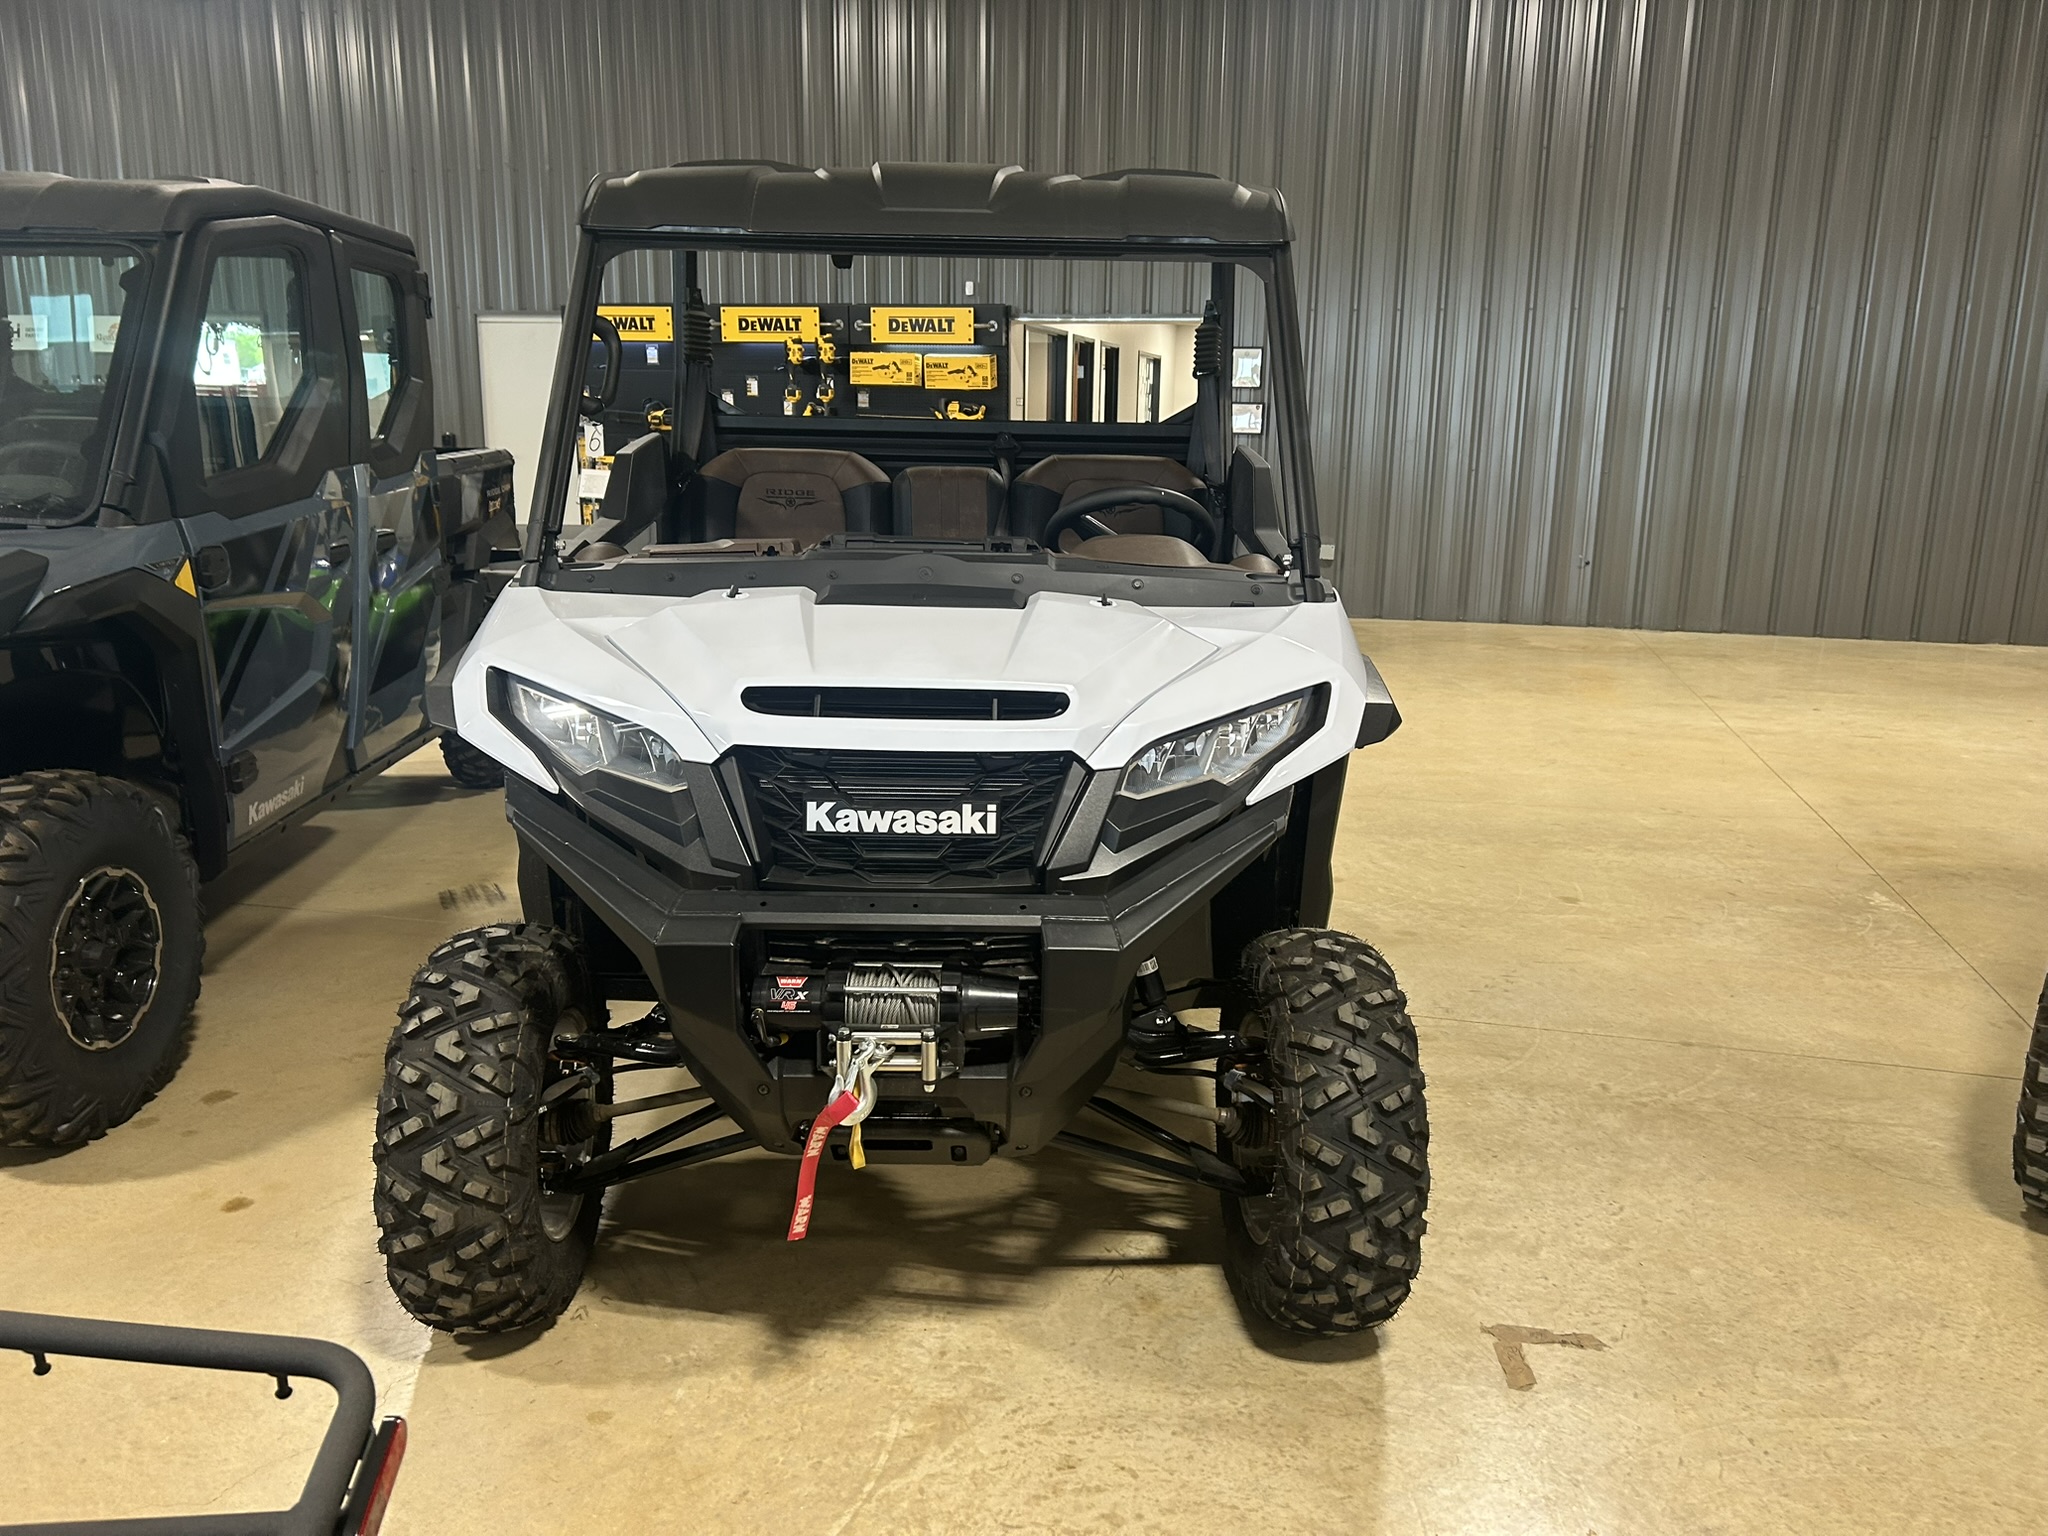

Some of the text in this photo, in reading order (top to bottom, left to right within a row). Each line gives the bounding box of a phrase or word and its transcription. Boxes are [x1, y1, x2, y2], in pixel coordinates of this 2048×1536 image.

[612, 317, 655, 330] WALT
[738, 318, 801, 331] DEWALT
[888, 319, 955, 332] DEWALT
[765, 488, 815, 496] RIDGE
[248, 776, 304, 825] Kawasaki
[806, 801, 997, 834] Kawasaki
[806, 1126, 829, 1158] WARN
[792, 1194, 813, 1234] WARN
